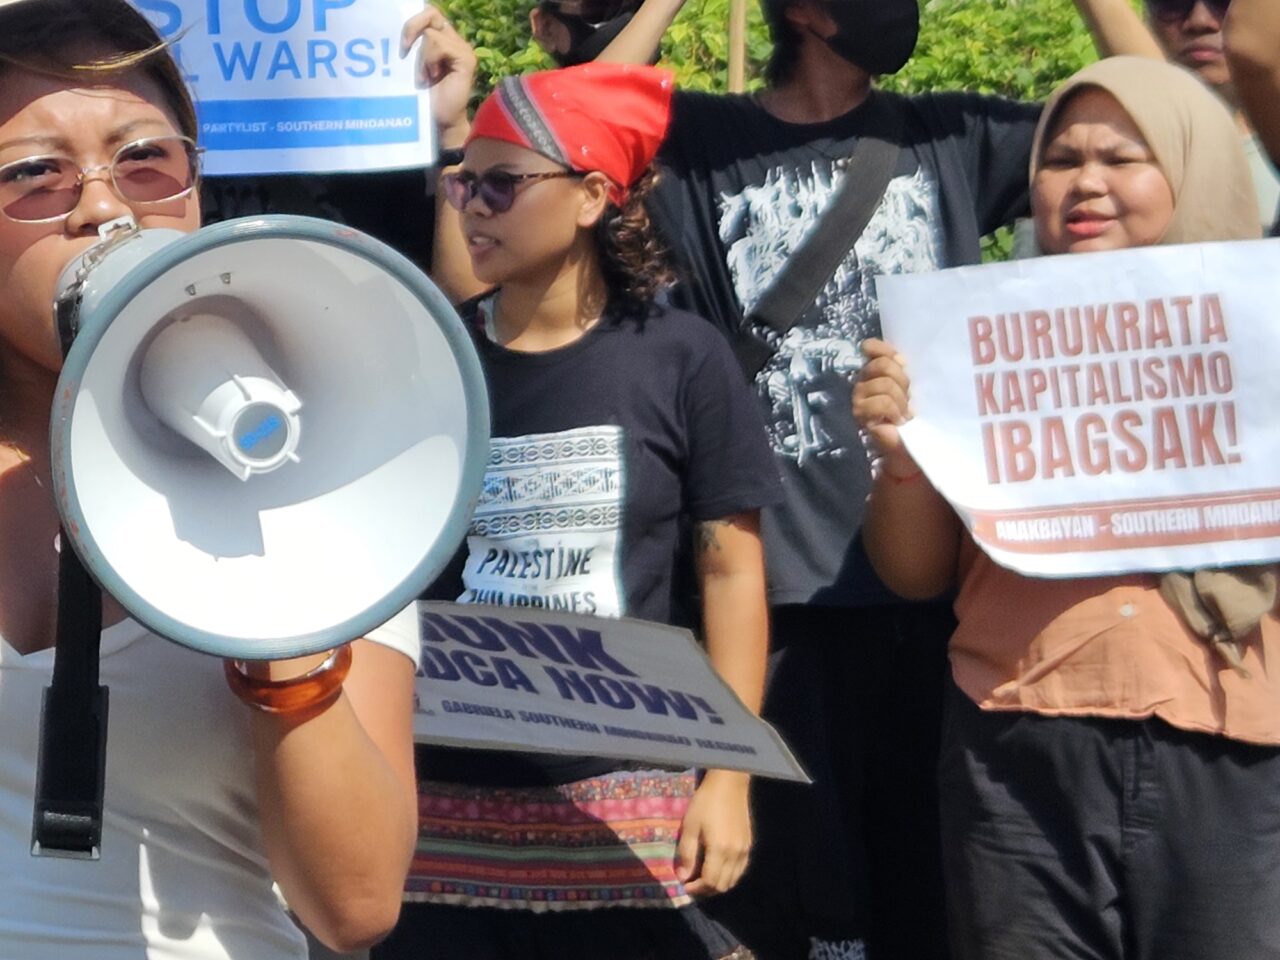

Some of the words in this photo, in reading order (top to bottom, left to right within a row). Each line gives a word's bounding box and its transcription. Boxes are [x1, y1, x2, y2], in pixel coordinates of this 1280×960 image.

[213, 38, 392, 82] WARS!
[202, 121, 267, 133] PARTYLIST
[276, 119, 343, 133] SOUTHERN
[344, 117, 413, 130] MINDANAO
[967, 293, 1228, 366] BURUKRATA
[973, 350, 1235, 417] KAPITALISMO
[981, 401, 1242, 485] IBAGSAK!
[996, 513, 1094, 540] ANAKBAYAN
[1110, 507, 1200, 536] SOUTHERN
[477, 542, 596, 580] PALESTINE
[416, 645, 540, 694] DCA
[542, 664, 725, 727] NOW!
[441, 700, 516, 721] GABRIELA
[518, 710, 600, 735] SOUTHERN
[695, 737, 757, 756] REGION
